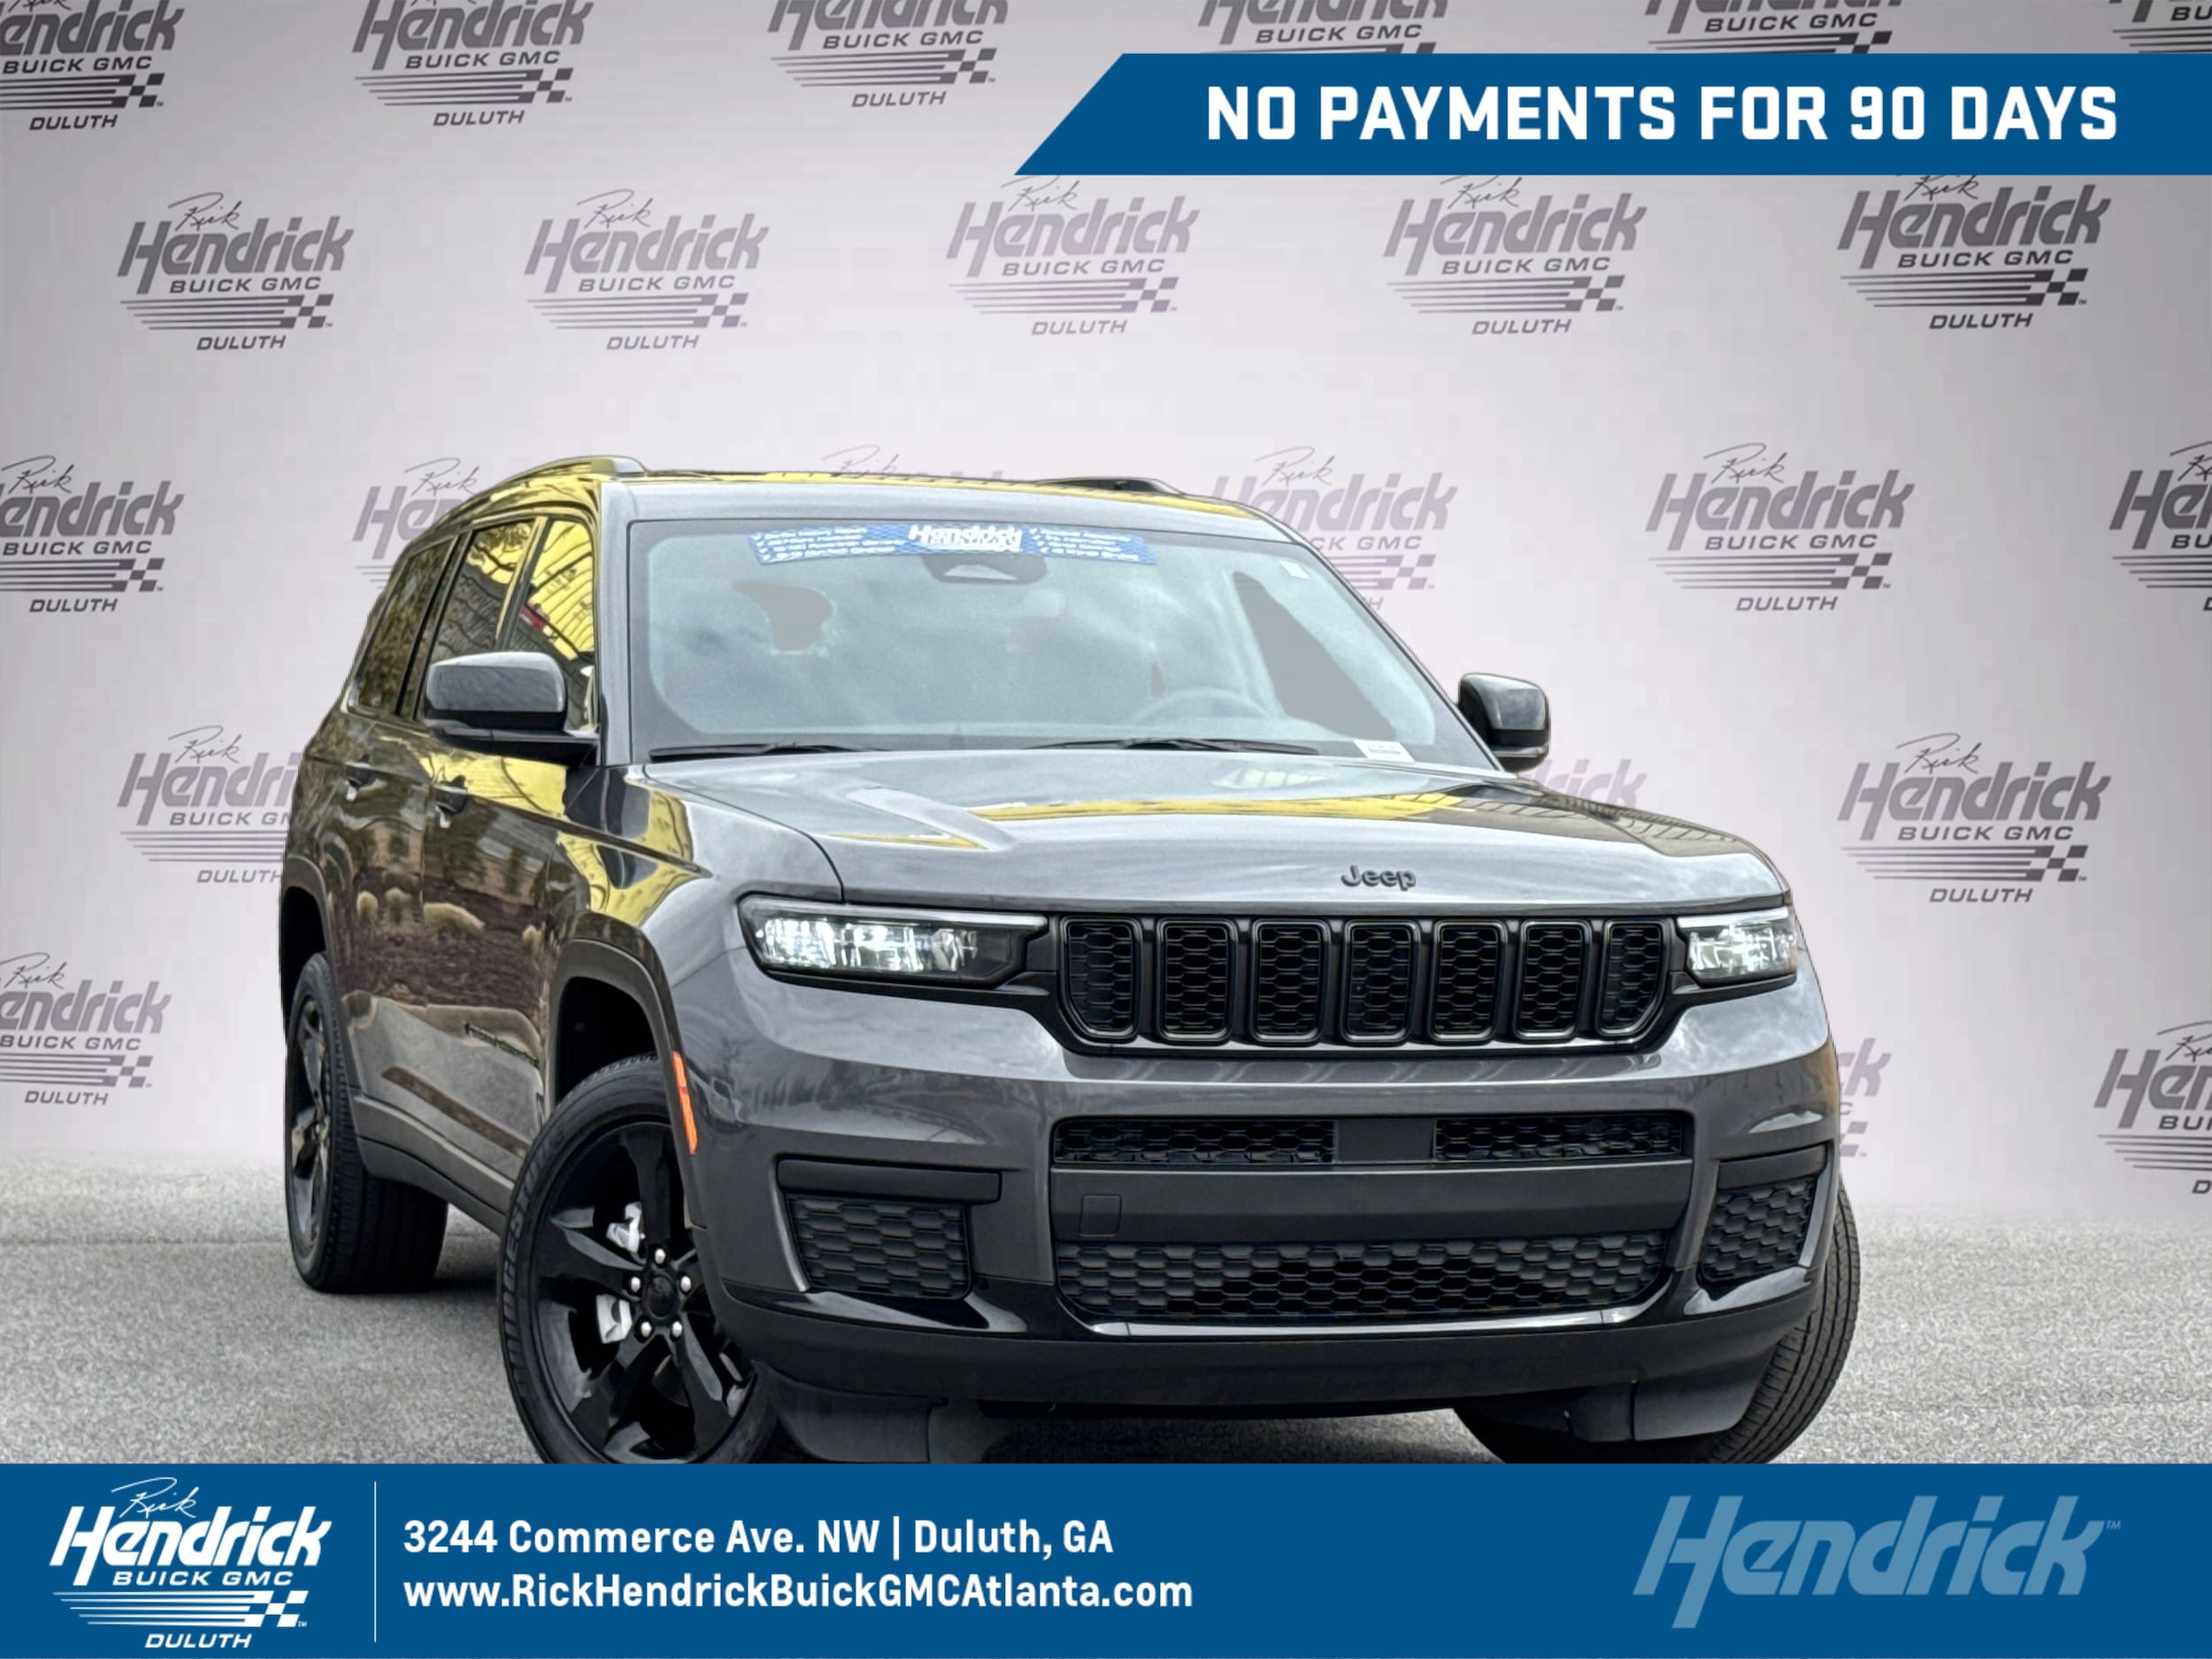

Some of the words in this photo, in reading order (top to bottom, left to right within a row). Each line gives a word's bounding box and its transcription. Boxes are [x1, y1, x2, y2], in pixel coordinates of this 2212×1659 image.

[0, 0, 185, 56] endrick
[1704, 15, 1800, 34] BUICK
[1809, 12, 1879, 29] GMC
[352, 0, 594, 70] Hendrick
[823, 33, 910, 50] BUICK
[919, 30, 984, 46] GMC
[1255, 26, 1348, 44] BUICK
[1356, 24, 1423, 41] GMC
[2, 58, 85, 74] BUICK
[93, 56, 153, 72] GMC
[404, 52, 490, 70] BUICK
[498, 50, 561, 67] GMC
[851, 91, 947, 108] DULUTH
[29, 114, 119, 131] DULUTH
[432, 110, 526, 127] DULUTH
[168, 192, 242, 230] Rick
[576, 189, 651, 228] Rick
[946, 196, 1200, 277] Hendrick
[1383, 192, 1647, 276] Hendrick
[1837, 184, 2112, 269] Hendrick
[117, 216, 355, 295] Hendrick
[525, 213, 769, 293] Hendrick
[1897, 252, 1993, 268] BUICK
[2003, 249, 2074, 265] GMC
[1002, 260, 1090, 277] BUICK
[1099, 257, 1166, 274] GMC
[1441, 259, 1534, 275] BUICK
[1543, 257, 1611, 273] GMC
[168, 277, 253, 294] BUICK
[260, 275, 322, 292] GMC
[578, 276, 664, 293] BUICK
[672, 274, 736, 291] GMC
[1030, 319, 1128, 336] DULUTH
[1471, 318, 1573, 335] DULUTH
[1928, 312, 2034, 330] DULUTH
[196, 334, 287, 351] DULUTH
[605, 334, 699, 351] DULUTH
[1254, 445, 1336, 486] Rick
[1702, 443, 1788, 483] Rick
[2, 455, 74, 494] Rick
[0, 480, 184, 538] endrick
[1646, 469, 1916, 551] Hendrick
[3, 541, 84, 557] BUICK
[93, 539, 153, 556] GMC
[1356, 535, 1423, 551] GMC
[1704, 535, 1798, 550] BUICK
[1809, 534, 1878, 549] GMC
[29, 598, 118, 613] DULUTH
[1735, 596, 1839, 612] DULUTH
[167, 725, 242, 764] Rick
[1896, 733, 1983, 774] Rick
[117, 752, 303, 826] Hendri
[1837, 761, 2113, 841] Hendrick
[169, 811, 252, 826] BUICK
[1897, 826, 1993, 842] BUICK
[2003, 826, 2074, 841] GMC
[1340, 864, 1417, 892] Jeep
[1929, 887, 2034, 903] DULUTH
[0, 979, 173, 1034] endrick
[0, 1034, 77, 1050] BUICK
[84, 1037, 142, 1052] GMC
[24, 1090, 109, 1106] DULUTH
